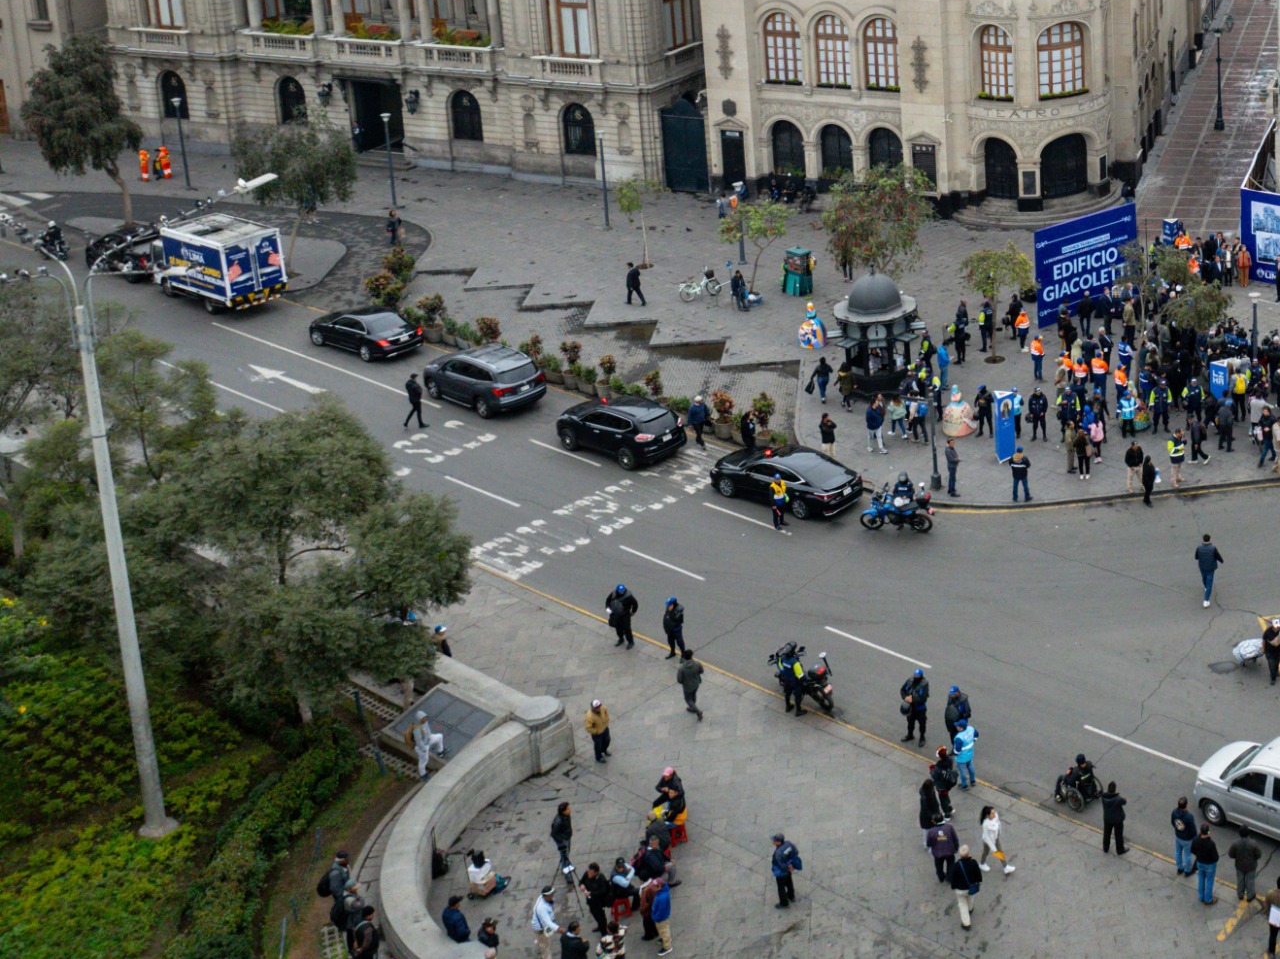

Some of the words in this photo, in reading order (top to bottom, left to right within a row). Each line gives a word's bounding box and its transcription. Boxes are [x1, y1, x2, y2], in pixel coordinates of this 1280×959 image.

[983, 107, 1060, 119] TEATRO
[188, 251, 205, 264] LIMA
[1053, 247, 1118, 281] EDIFICIO
[1264, 272, 1277, 280] LIM
